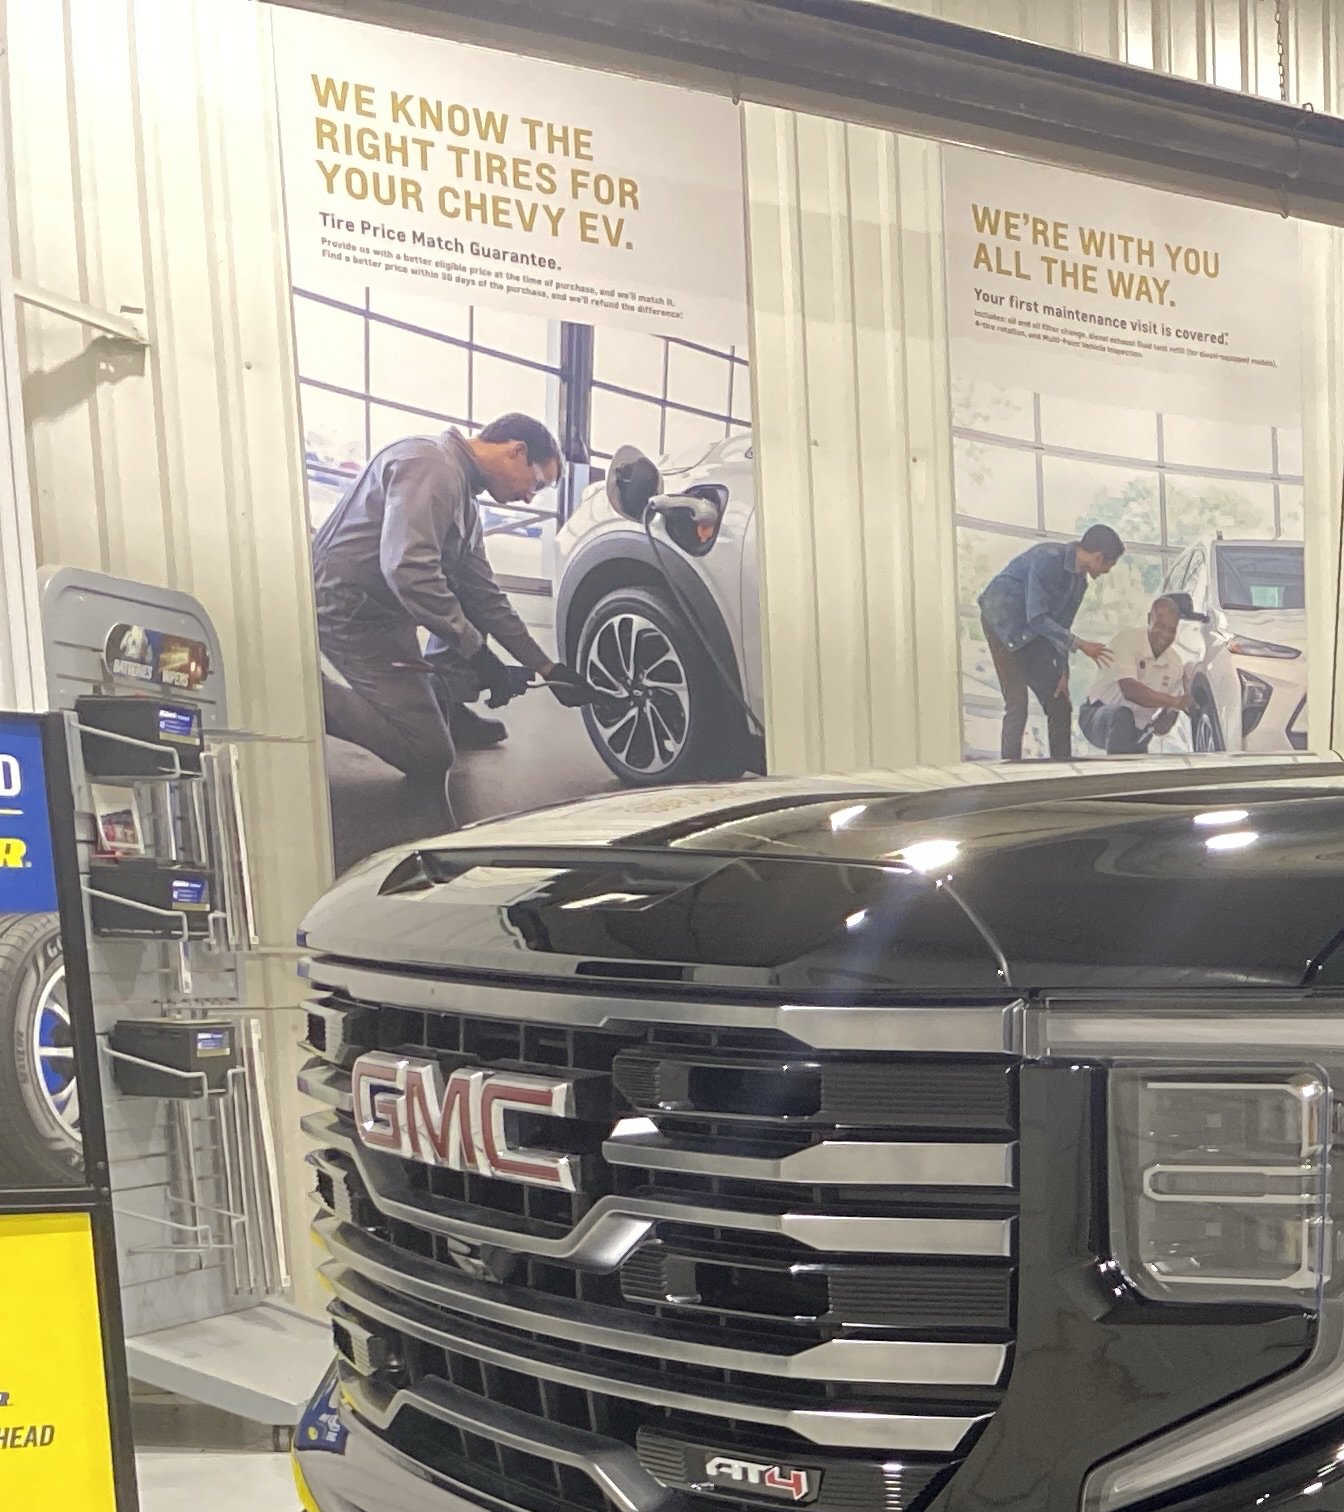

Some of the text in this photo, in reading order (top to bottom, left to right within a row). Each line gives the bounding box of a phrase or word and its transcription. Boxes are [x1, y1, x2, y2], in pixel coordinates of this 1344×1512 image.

[311, 73, 594, 161] WE KNOW THE
[315, 116, 639, 210] RIGHT TIRES FOR
[315, 159, 634, 250] YOUR CHEVY EV.
[319, 211, 562, 270] Tire Price Match Guarantee.
[373, 249, 393, 259] with
[403, 253, 432, 267] better
[469, 267, 492, 278] price
[506, 272, 520, 282] the
[599, 288, 615, 297] and
[972, 203, 1220, 279] WE'RE WITH YOU
[321, 249, 342, 261] Find
[352, 254, 382, 268] better
[384, 263, 408, 275] price
[455, 275, 476, 287] days
[489, 281, 504, 290] the
[551, 292, 567, 301] and
[973, 242, 1176, 308] ALL THE WAY.
[973, 287, 1005, 306] Your
[1009, 295, 1040, 313] first
[1043, 304, 1127, 330] maintenance
[1130, 319, 1158, 335] visit
[1161, 323, 1172, 337] is
[352, 1050, 580, 1191] GMC
[706, 1446, 809, 1501] AT4
